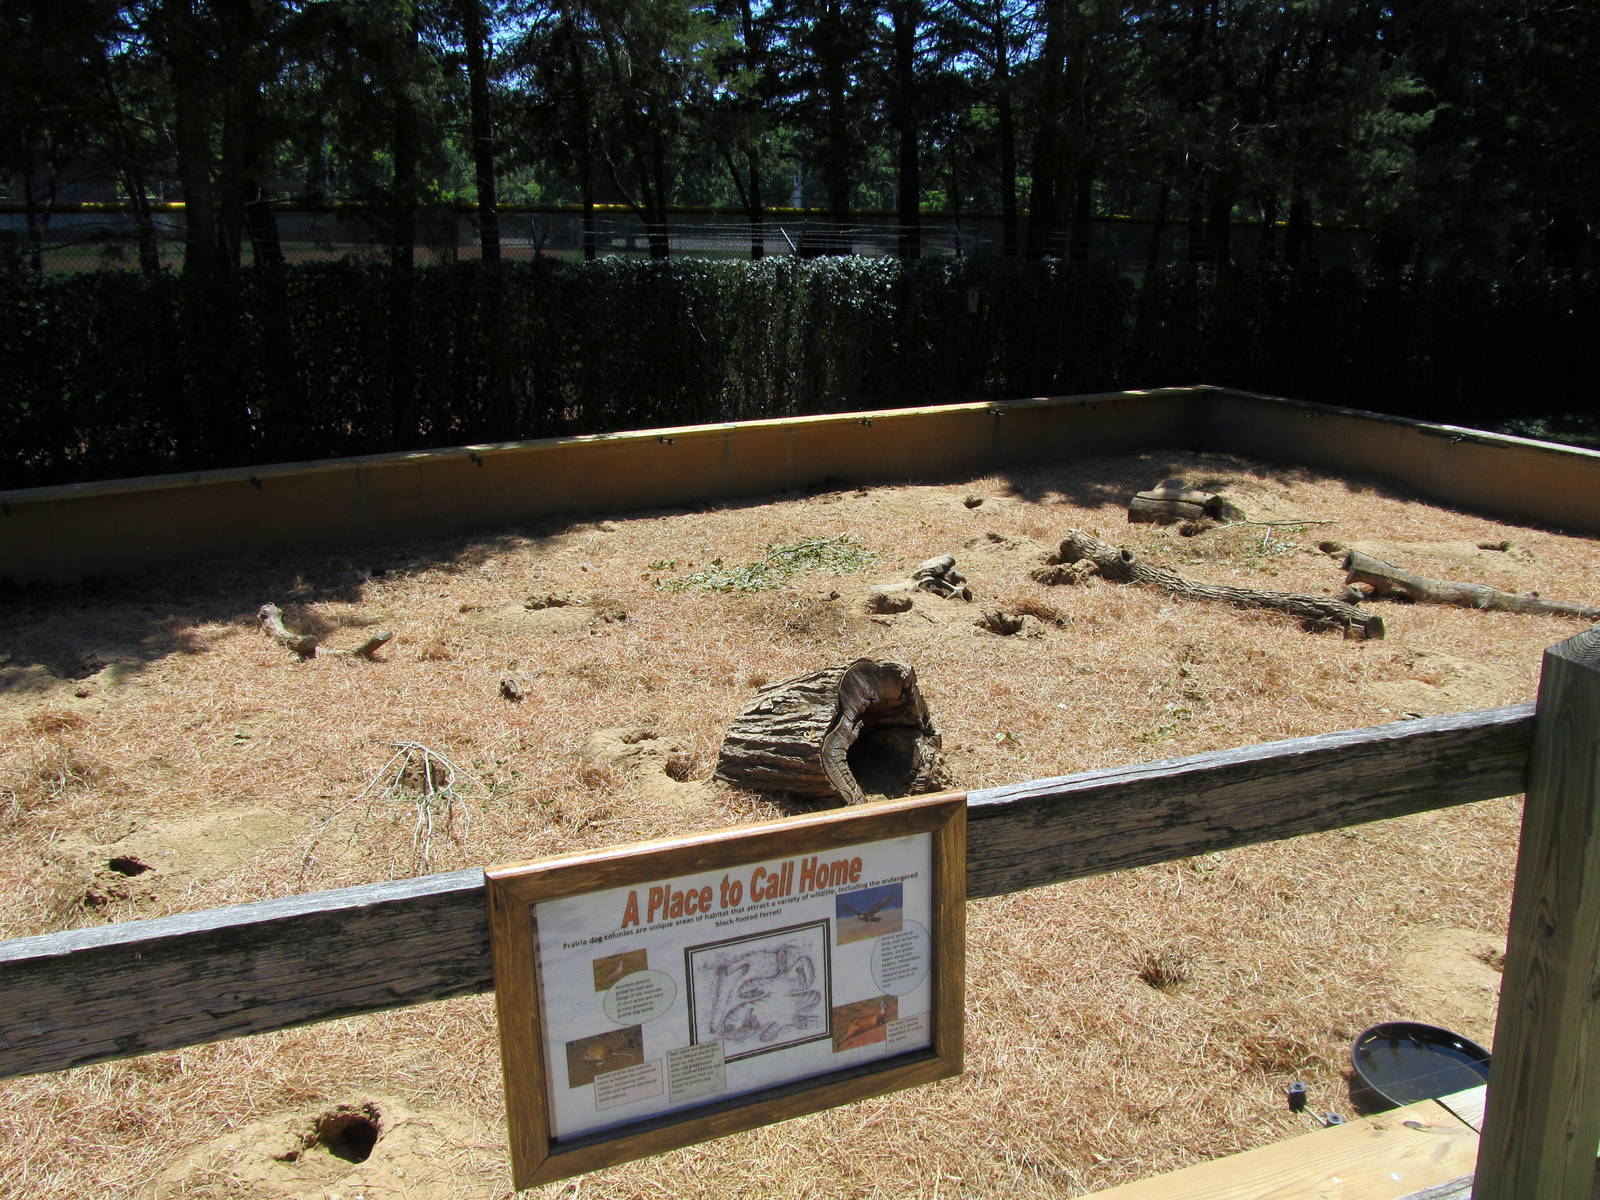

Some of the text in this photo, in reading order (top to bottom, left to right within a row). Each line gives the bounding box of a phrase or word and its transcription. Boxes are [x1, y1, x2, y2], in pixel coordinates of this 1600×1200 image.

[563, 938, 588, 950] Prairie
[589, 936, 603, 944] dog
[604, 930, 634, 940] colonies
[649, 922, 674, 932] unique
[675, 918, 694, 926] areas
[704, 910, 729, 920] habitat
[730, 906, 745, 916] that
[746, 902, 770, 913] attract
[776, 896, 800, 906] variety
[810, 889, 837, 899] wildlife,
[838, 882, 868, 894] including
[869, 879, 880, 887] the
[881, 872, 918, 884] endangered
[620, 856, 862, 928] A Place to Call Home
[715, 909, 782, 927] black-footed ferret!
